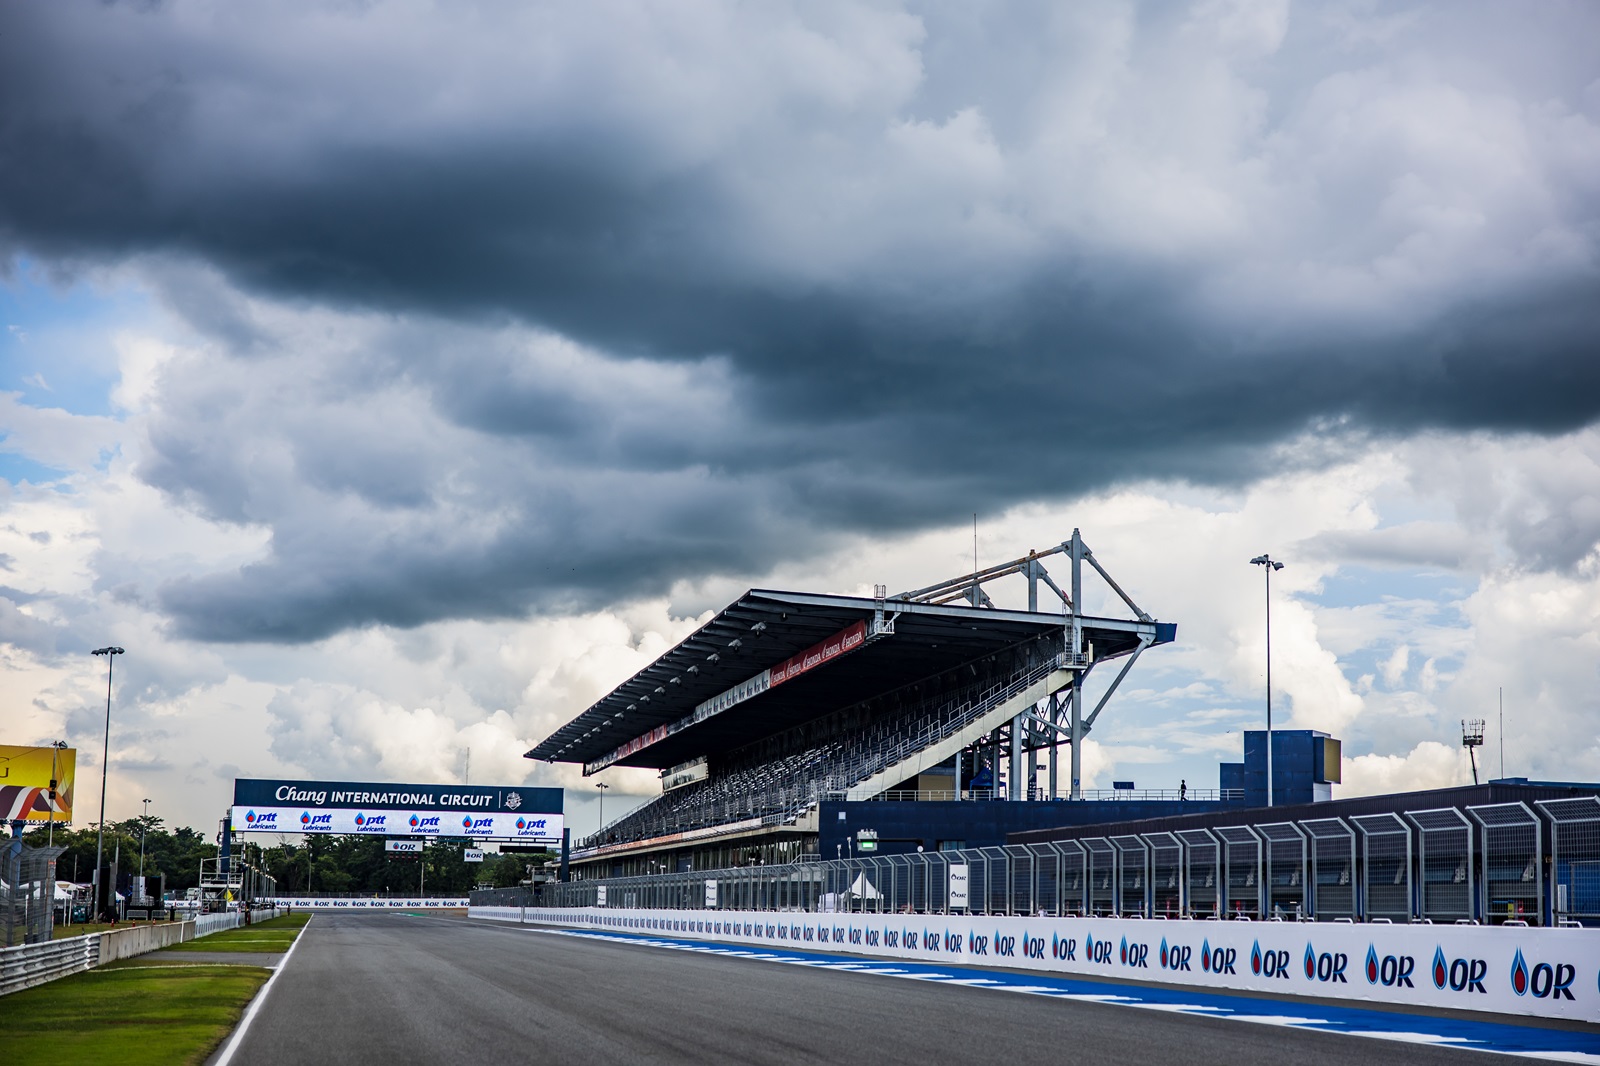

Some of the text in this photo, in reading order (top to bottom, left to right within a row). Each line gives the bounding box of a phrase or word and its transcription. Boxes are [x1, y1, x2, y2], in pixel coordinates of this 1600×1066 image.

[806, 653, 821, 668] HONDA
[826, 643, 840, 658] HONDA
[846, 632, 862, 648] HONDA
[275, 786, 492, 806] Chang INTERNATIONAL CIRCUIT
[256, 812, 546, 830] ptt ptt ptt ptt ptt ptt
[1522, 866, 1534, 879] 40
[736, 924, 741, 936] OR
[746, 924, 752, 936] OR
[757, 925, 763, 937] OR
[768, 925, 775, 939] OR
[780, 926, 787, 939] OR
[794, 926, 800, 940] OR
[806, 927, 814, 942] OR
[821, 928, 829, 943] OR
[835, 928, 844, 943] OR
[852, 929, 861, 945] OR
[869, 930, 879, 947] OR
[888, 931, 898, 948] OR
[906, 932, 917, 950] OR
[928, 933, 939, 951] OR
[950, 934, 962, 953] OR
[974, 936, 988, 955] OR
[1000, 936, 1014, 957] OR
[1029, 937, 1045, 959] OR
[1059, 938, 1076, 961] OR
[1094, 940, 1112, 964] OR
[1129, 943, 1148, 968] OR
[1169, 945, 1191, 971] OR
[1212, 948, 1236, 975] OR
[1263, 950, 1290, 979] OR
[1318, 952, 1348, 983] OR
[1380, 955, 1414, 988] OR
[1450, 958, 1487, 993] OR
[1530, 963, 1576, 1000] OR
